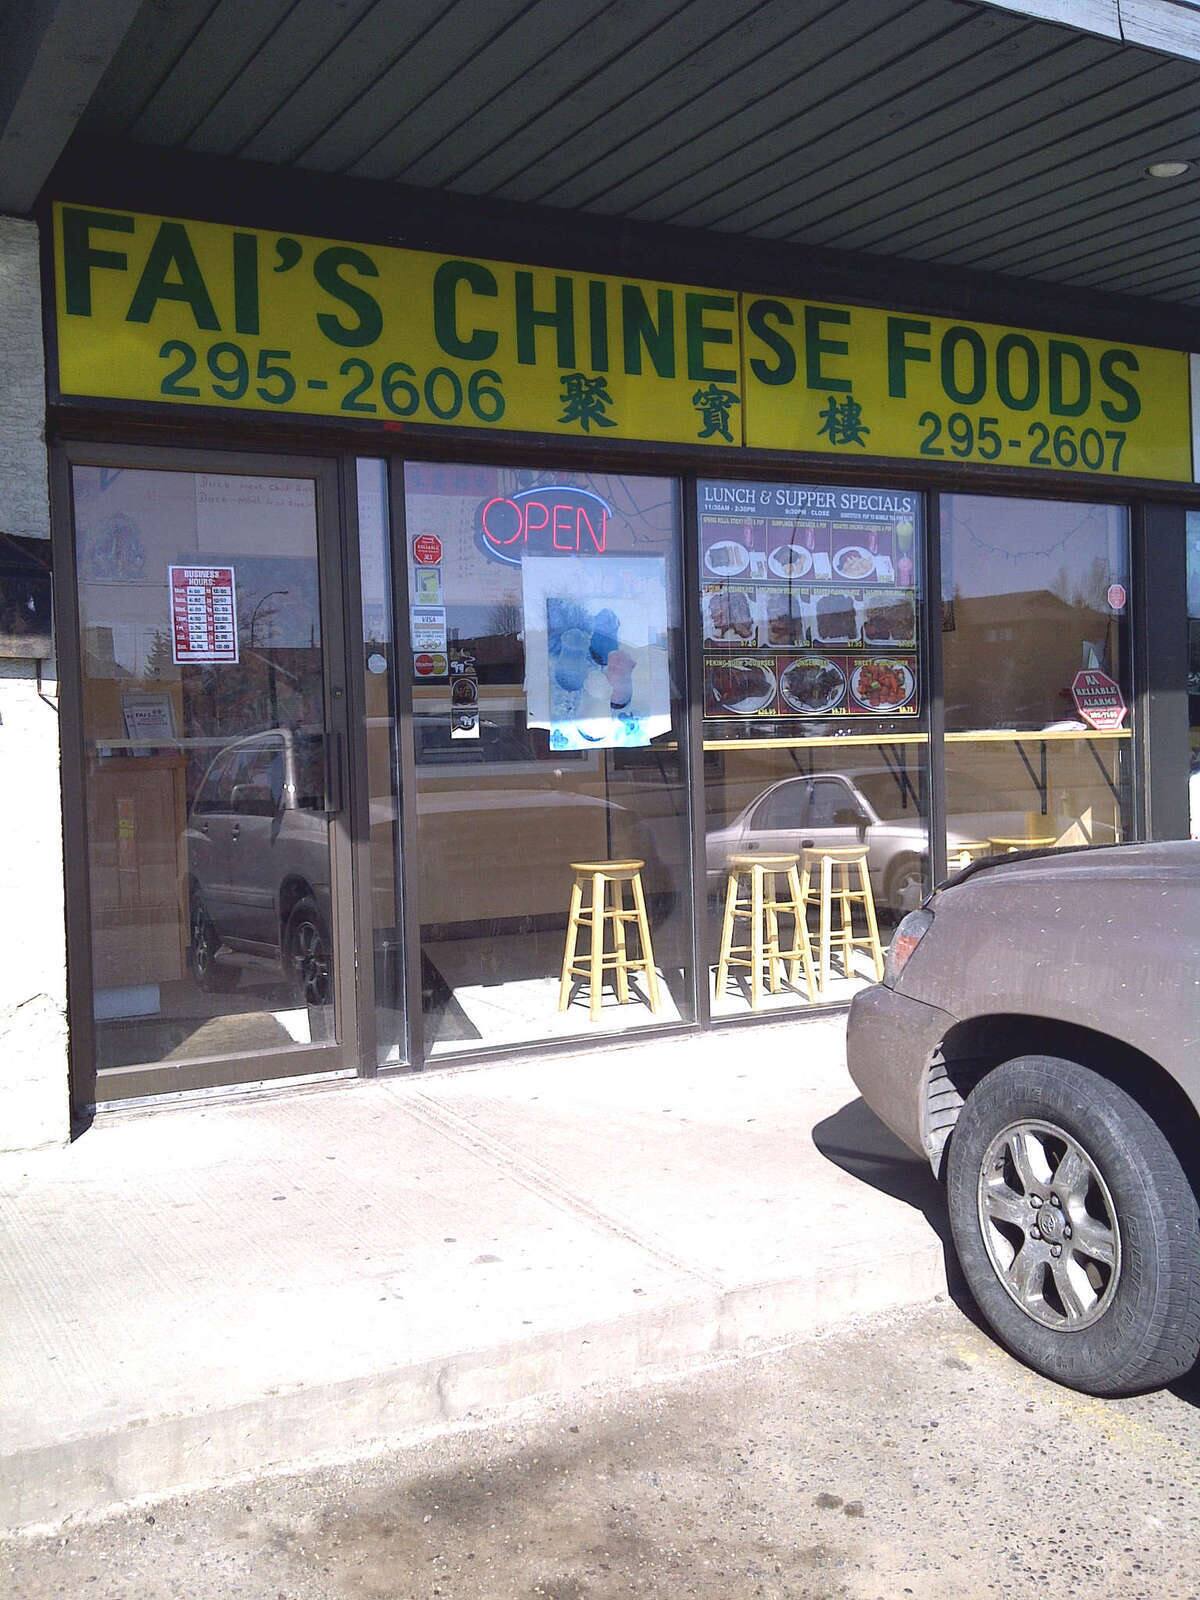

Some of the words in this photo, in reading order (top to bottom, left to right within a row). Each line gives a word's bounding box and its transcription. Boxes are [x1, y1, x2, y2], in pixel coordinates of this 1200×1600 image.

[62, 207, 384, 349] FAI'S
[434, 260, 852, 392] CHINESE
[886, 316, 1142, 424] FOODS
[158, 339, 505, 424] 295-2606
[918, 411, 1127, 473] 295-2607
[482, 497, 608, 553] OPEN
[704, 486, 756, 505] LUNCH
[760, 490, 772, 504] &
[776, 490, 837, 509] SUPPER
[841, 493, 912, 513] SPECIALS
[1076, 686, 1117, 696] RELIABLE
[1083, 698, 1117, 706] ALARMS
